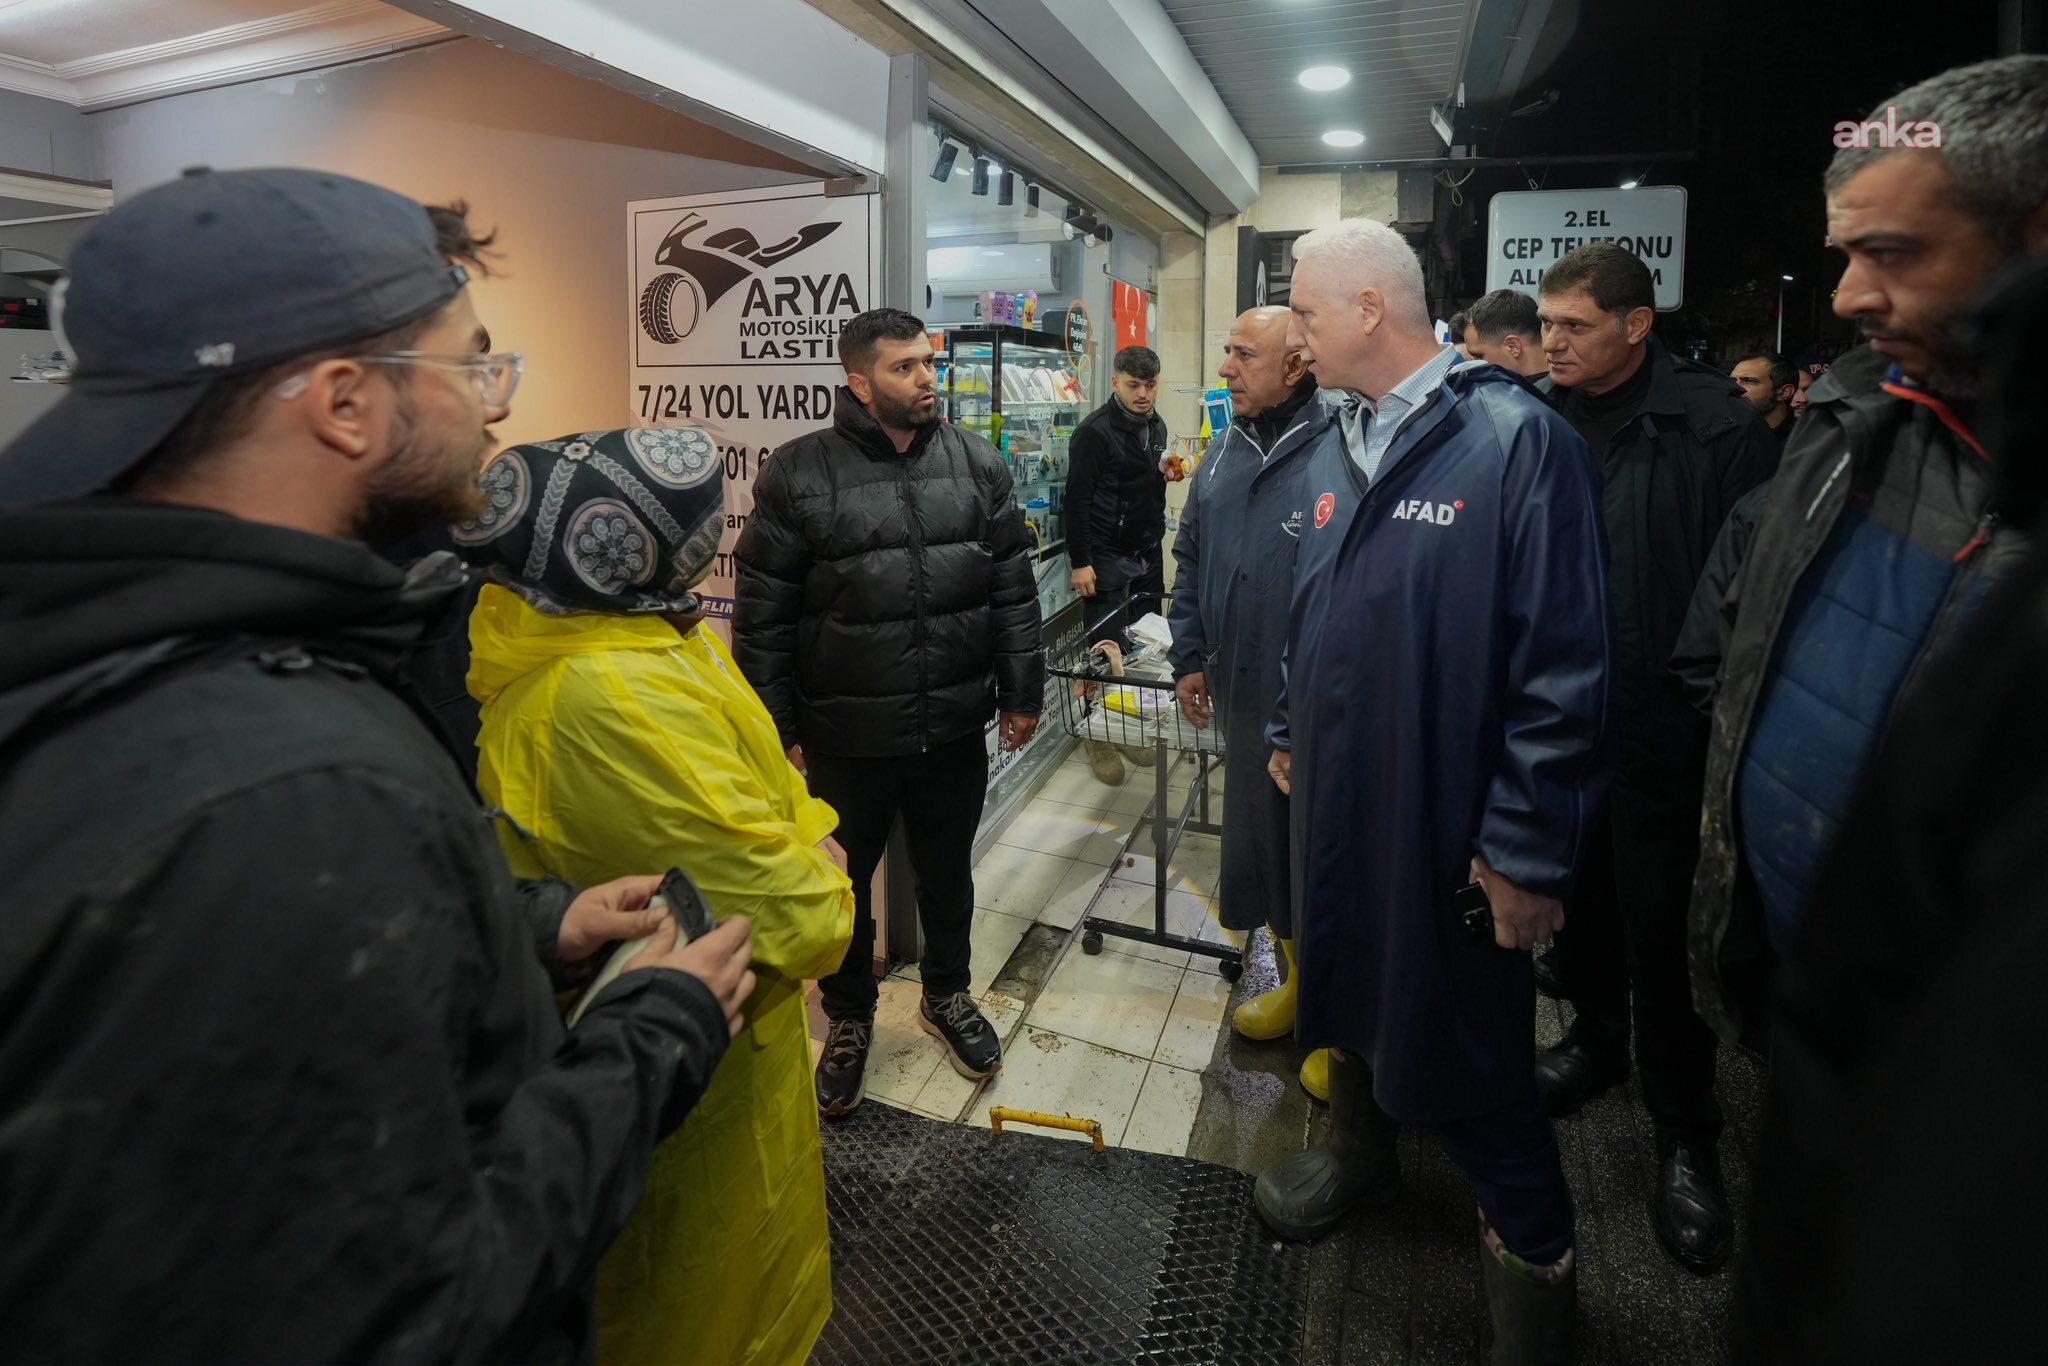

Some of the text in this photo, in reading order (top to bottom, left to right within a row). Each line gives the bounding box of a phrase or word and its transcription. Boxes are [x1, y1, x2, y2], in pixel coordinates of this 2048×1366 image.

[1564, 210, 1610, 228] 2.EL
[1503, 237, 1543, 260] CEP
[741, 273, 861, 318] ARYA
[740, 316, 853, 337] MOTOSİKLE
[741, 334, 834, 360] LASTİ
[638, 384, 840, 423] 7/24 YOL YARD
[1291, 511, 1303, 520] AF
[1392, 499, 1456, 526] AFAD
